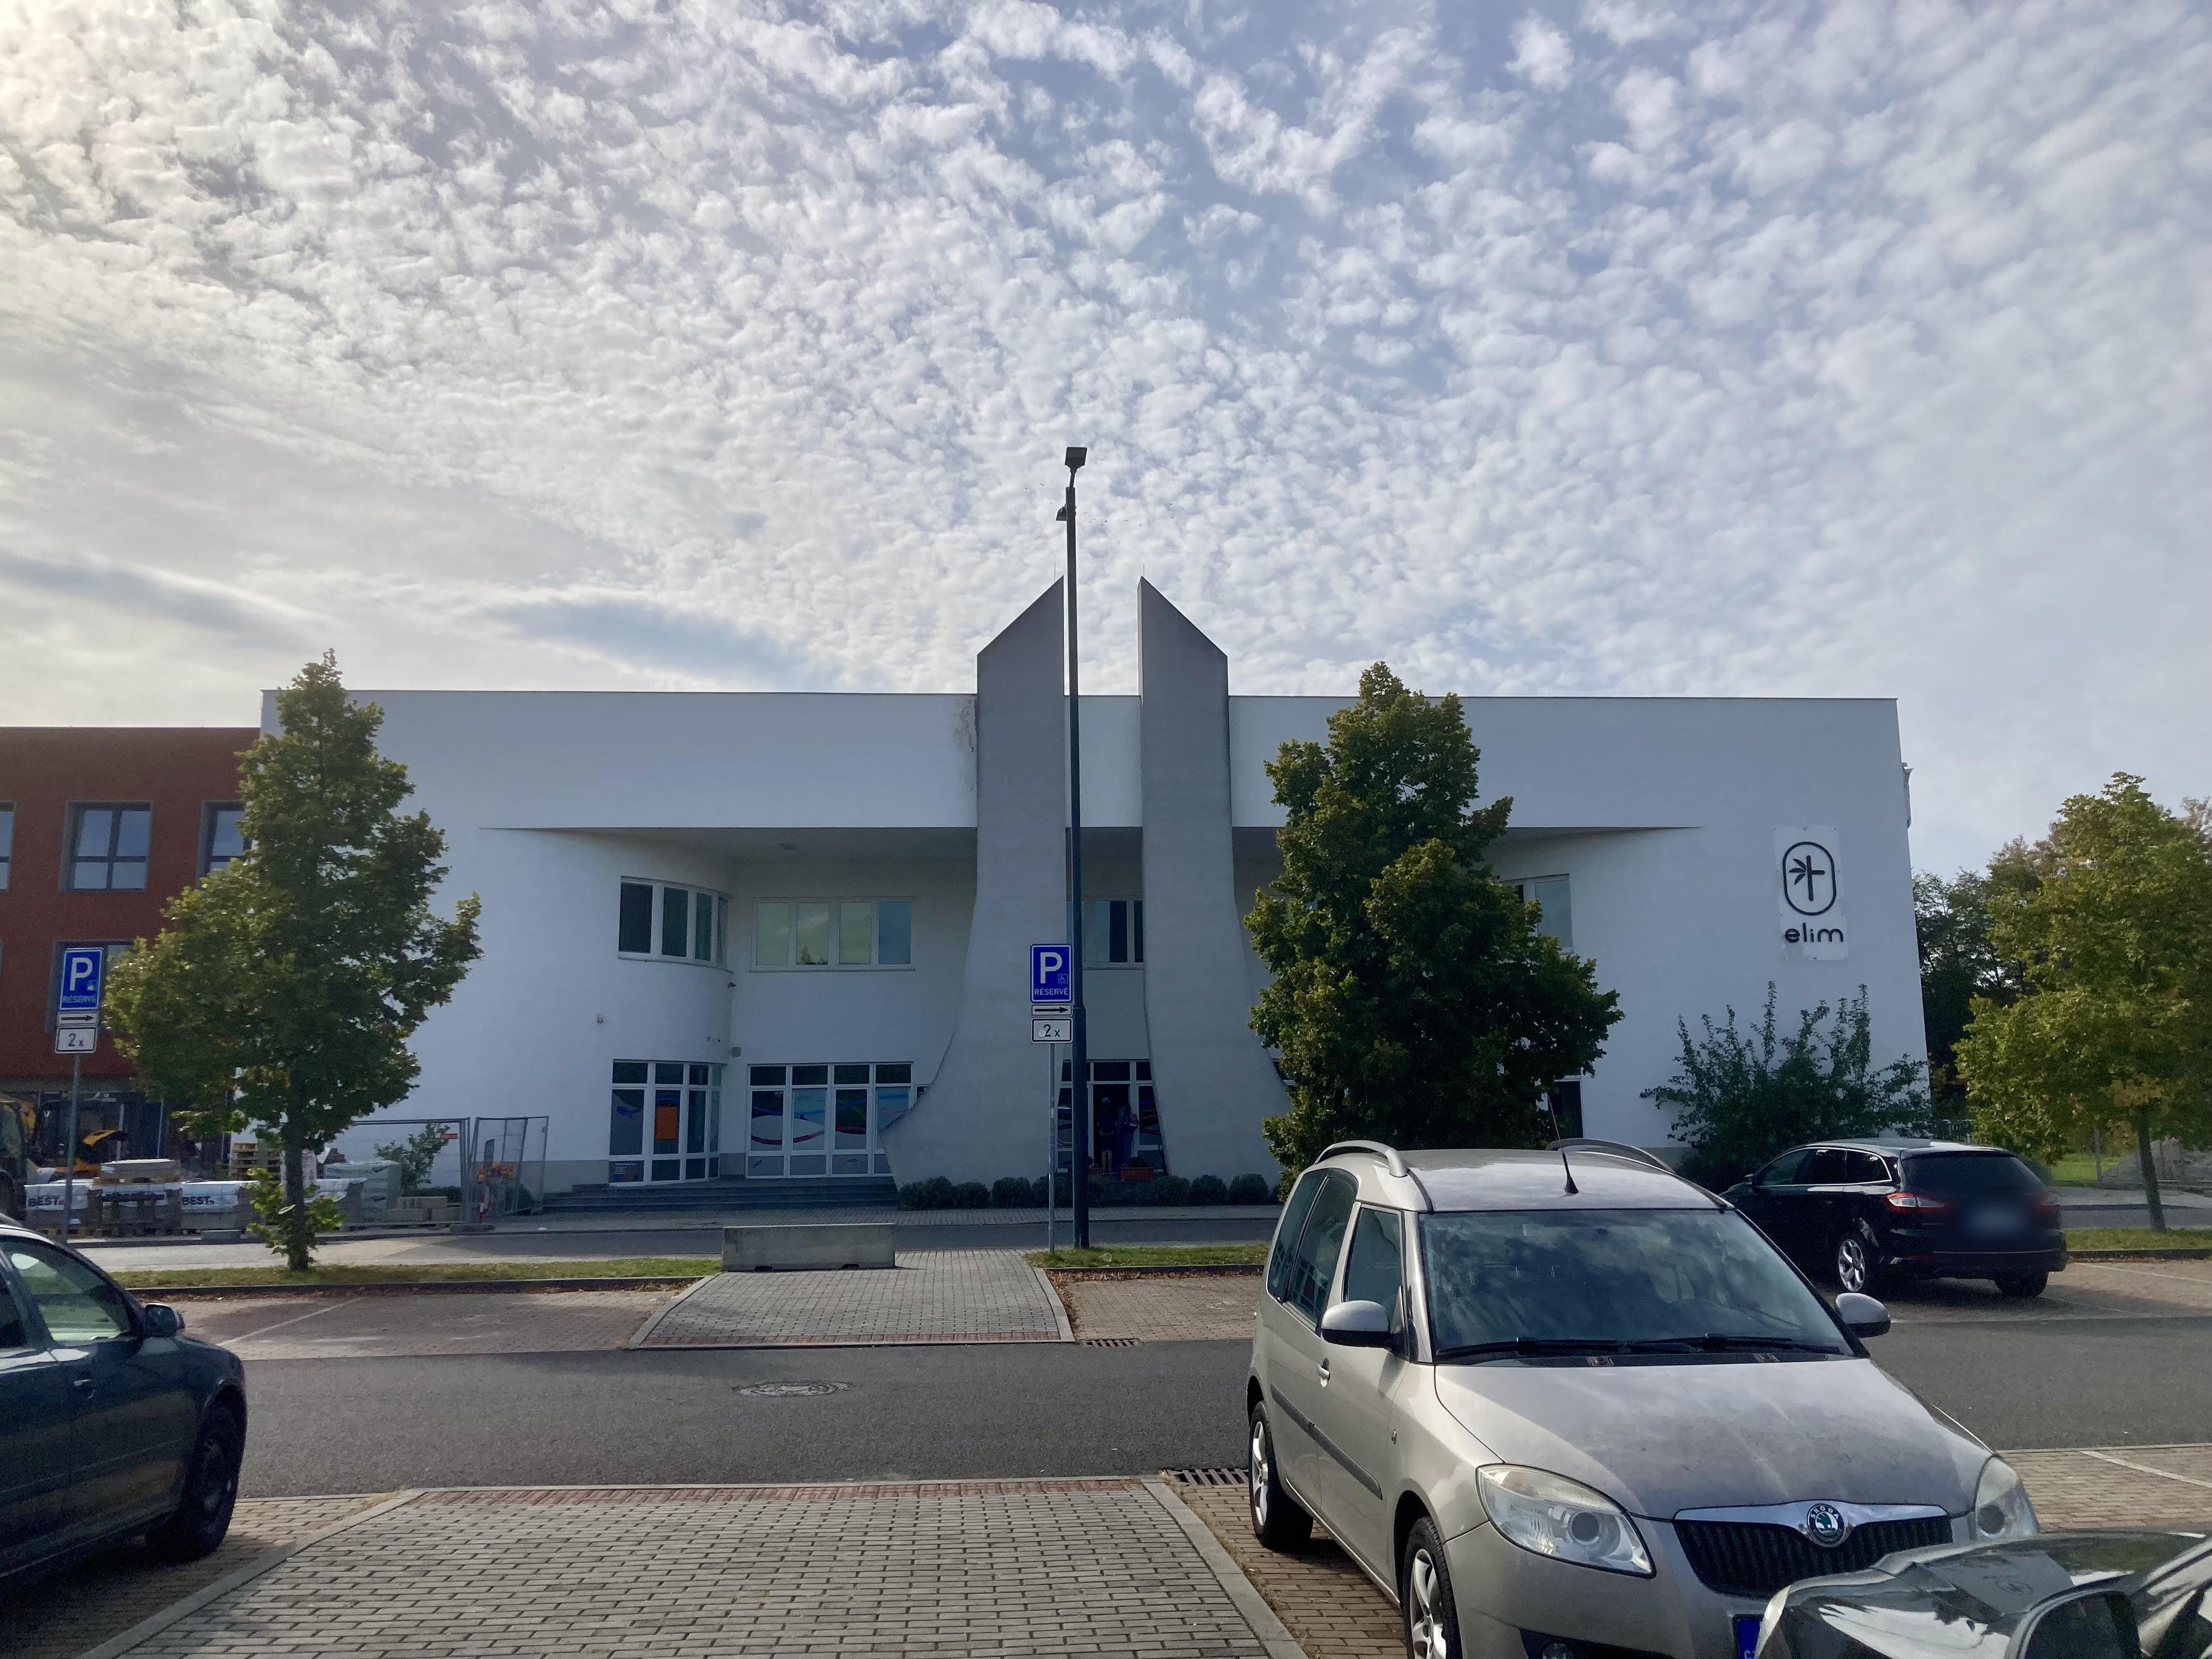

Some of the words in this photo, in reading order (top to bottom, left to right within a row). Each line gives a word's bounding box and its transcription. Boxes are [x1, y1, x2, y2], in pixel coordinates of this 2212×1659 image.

[1785, 922, 1844, 943] elim
[70, 957, 93, 991] P
[1040, 952, 1062, 984] P
[1034, 987, 1068, 995] RÉSERVÉ
